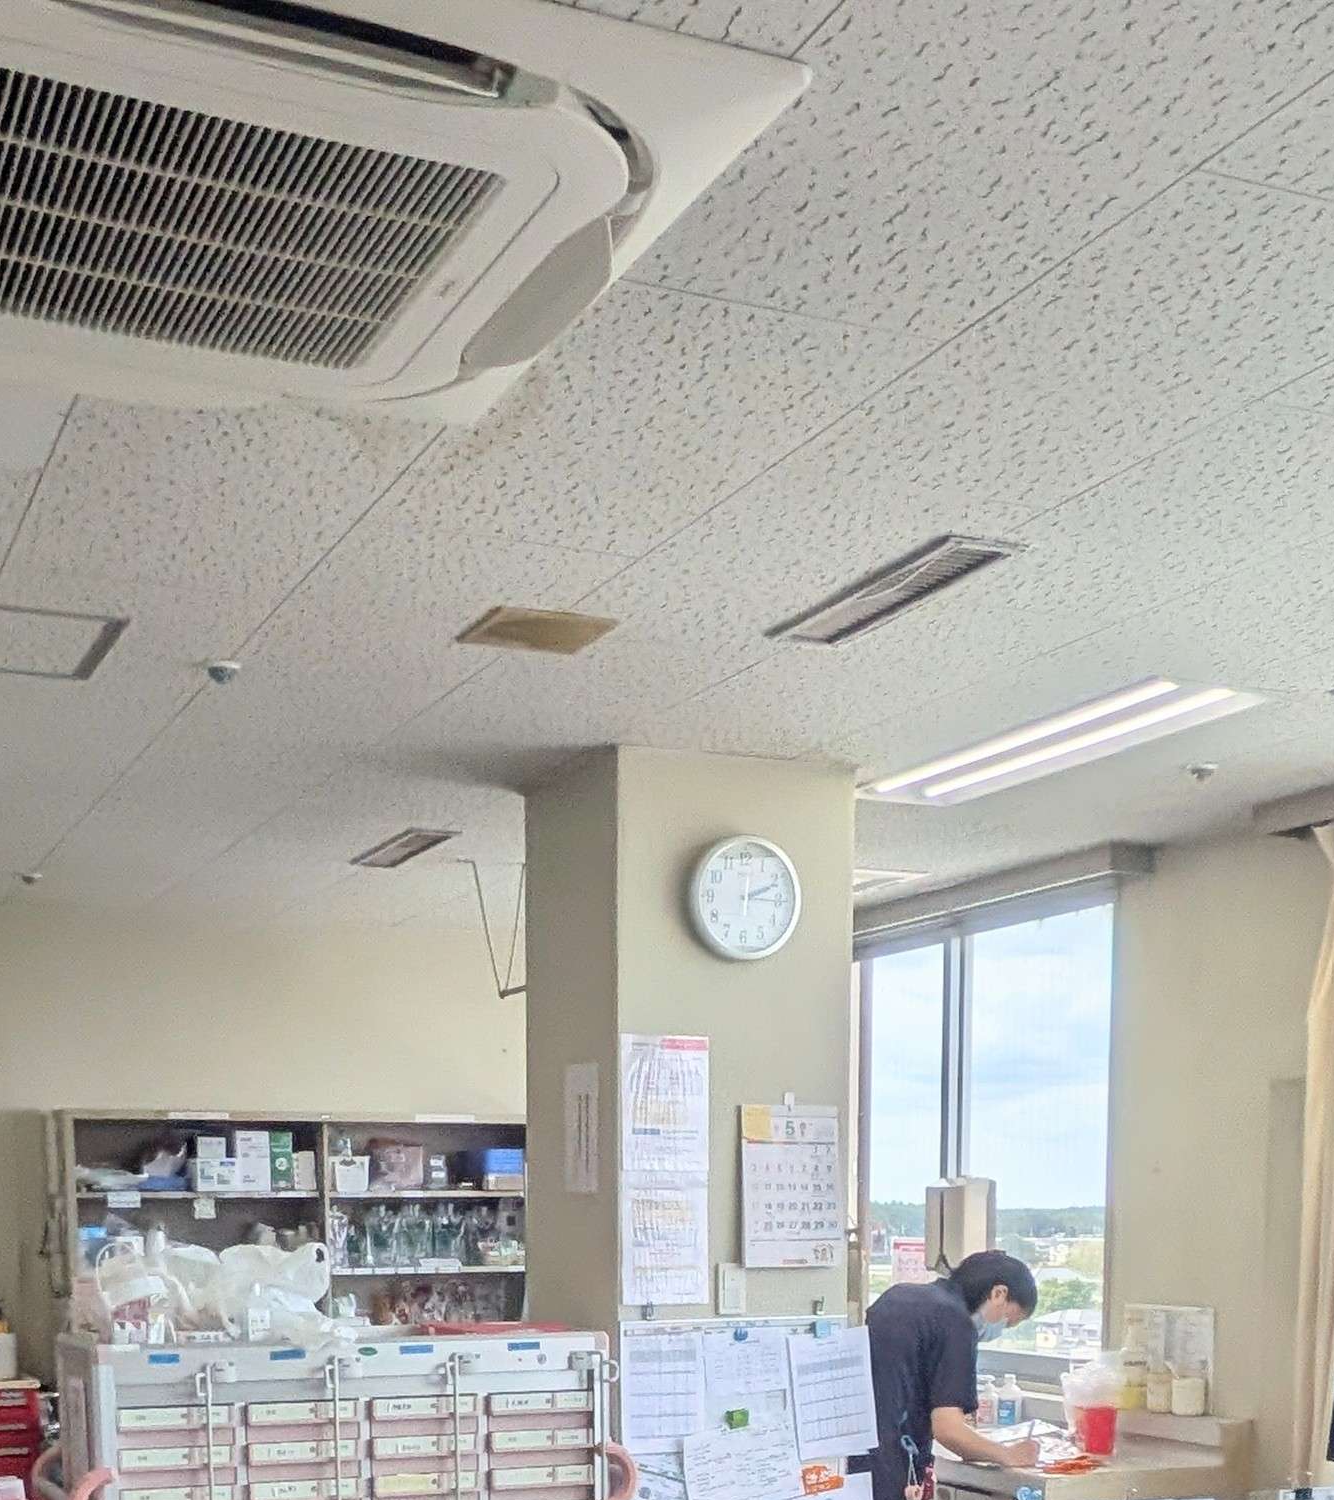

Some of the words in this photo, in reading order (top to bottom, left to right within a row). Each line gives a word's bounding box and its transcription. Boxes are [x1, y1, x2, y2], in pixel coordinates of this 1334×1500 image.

[723, 855, 734, 870] 11
[739, 852, 753, 866] 12
[710, 870, 723, 884] 10
[706, 888, 715, 903] 9
[709, 908, 719, 924] 8
[722, 923, 731, 939] 7
[738, 930, 747, 944] 6
[755, 926, 765, 940] 5
[785, 1119, 796, 1136] 5
